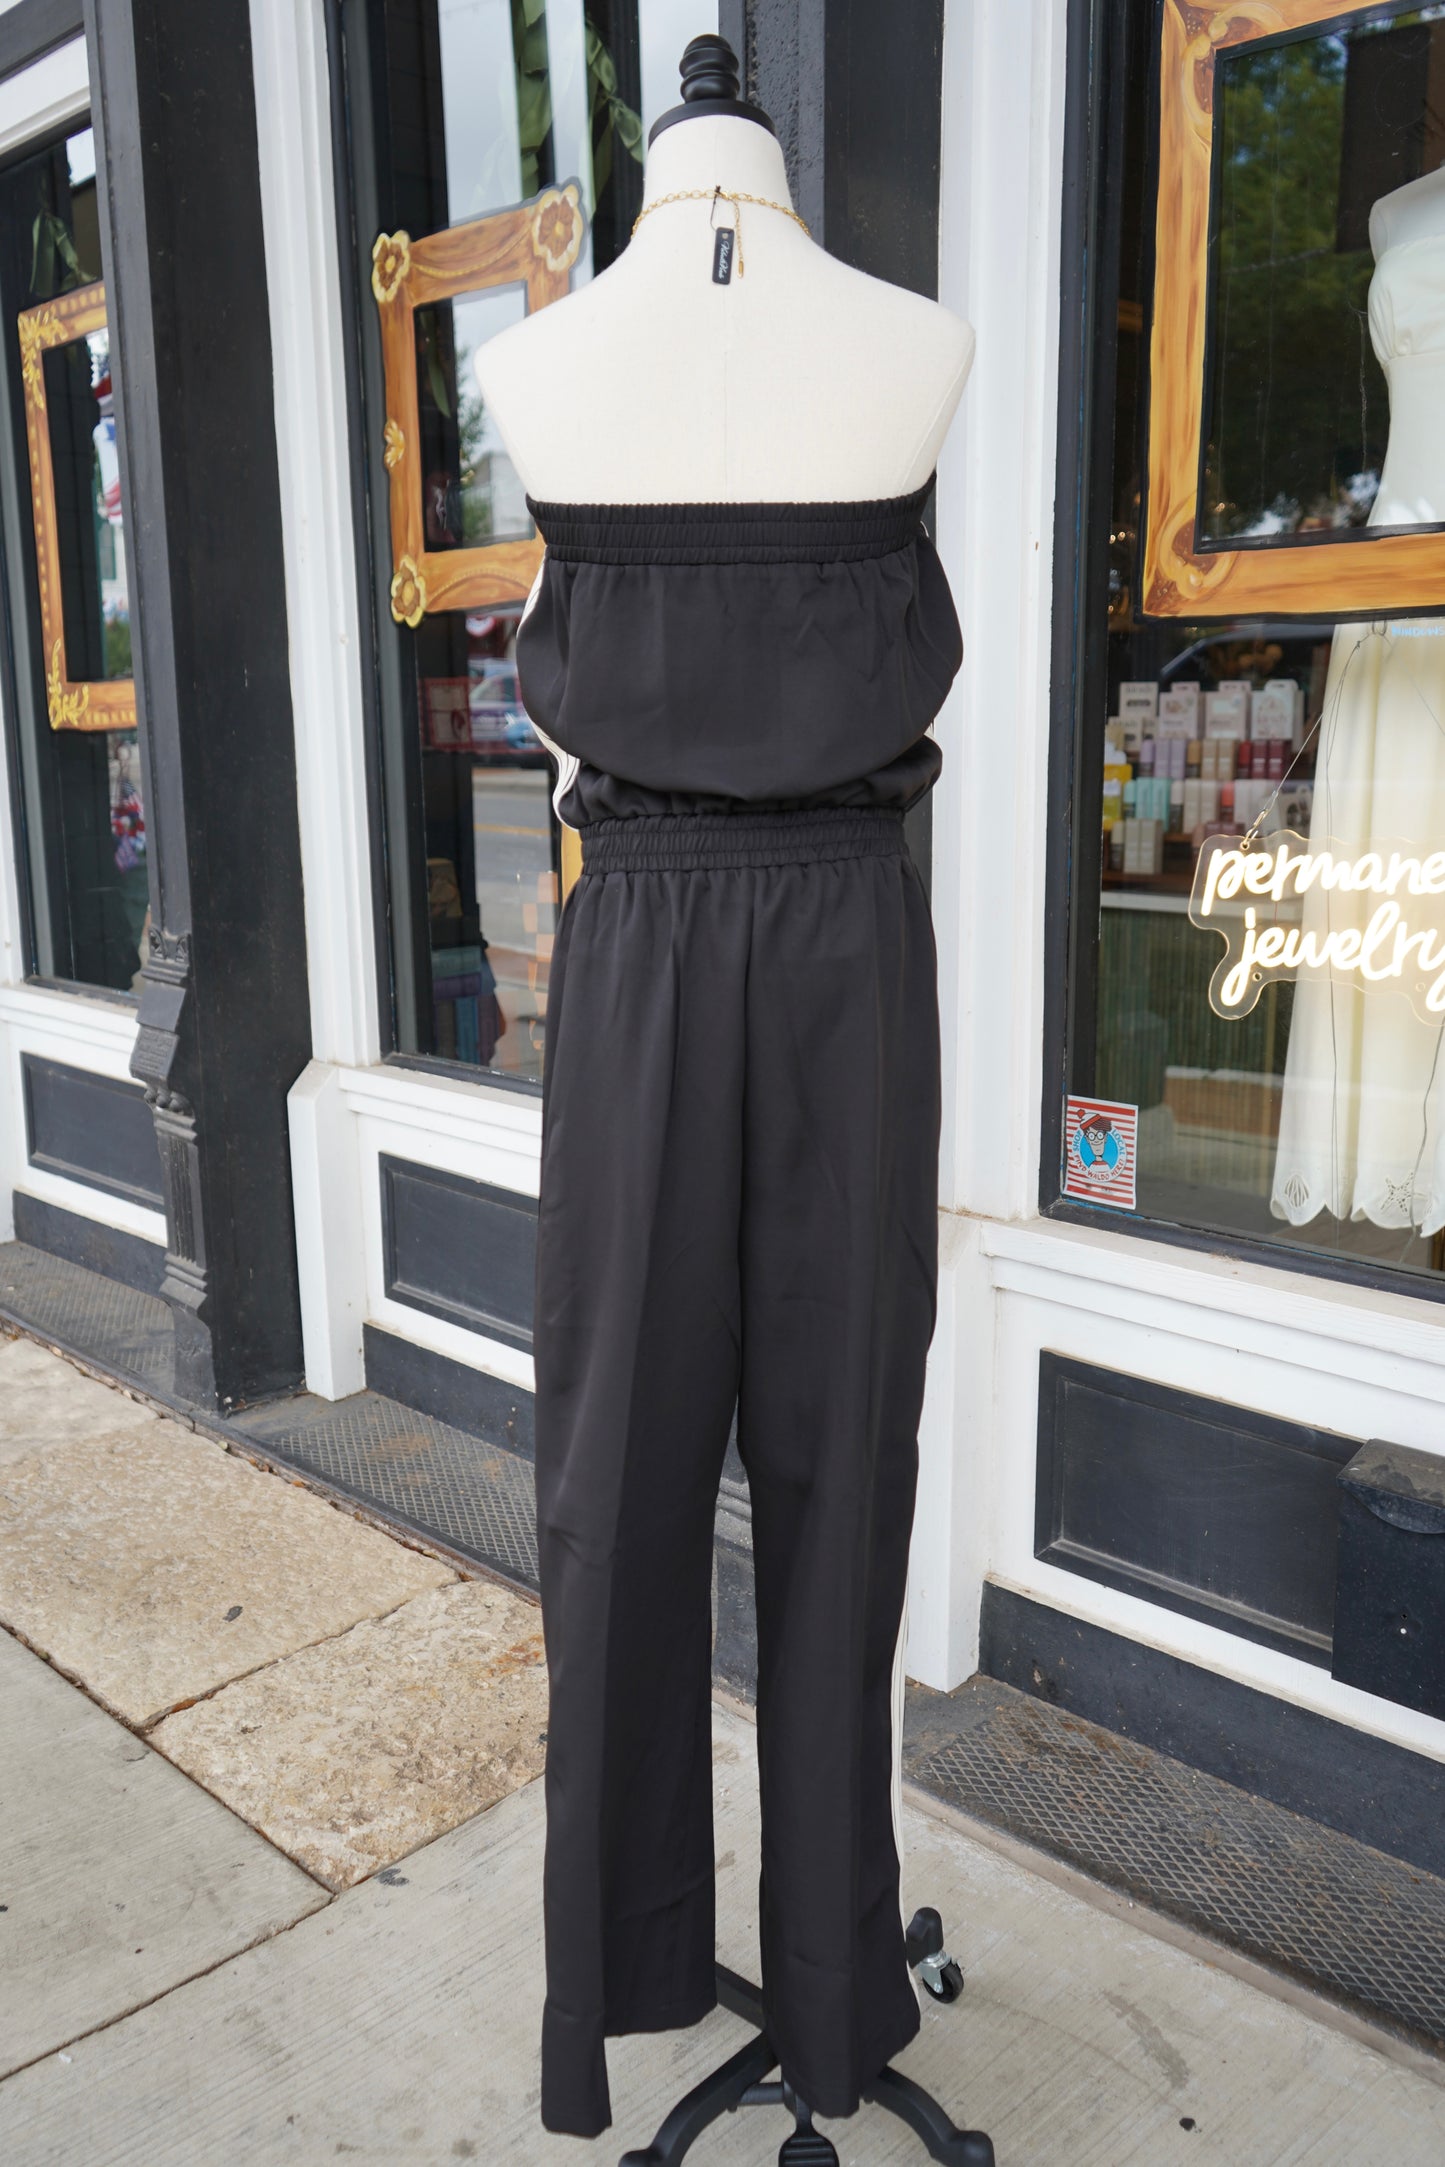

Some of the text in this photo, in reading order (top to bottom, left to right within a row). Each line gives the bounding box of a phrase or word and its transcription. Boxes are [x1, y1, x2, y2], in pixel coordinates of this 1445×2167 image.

[1220, 900, 1445, 1012] jewelry
[1072, 1129, 1125, 1155] SHOP LOCAL
[1075, 1154, 1087, 1172] FIND
[1087, 1170, 1110, 1181] WALDO
